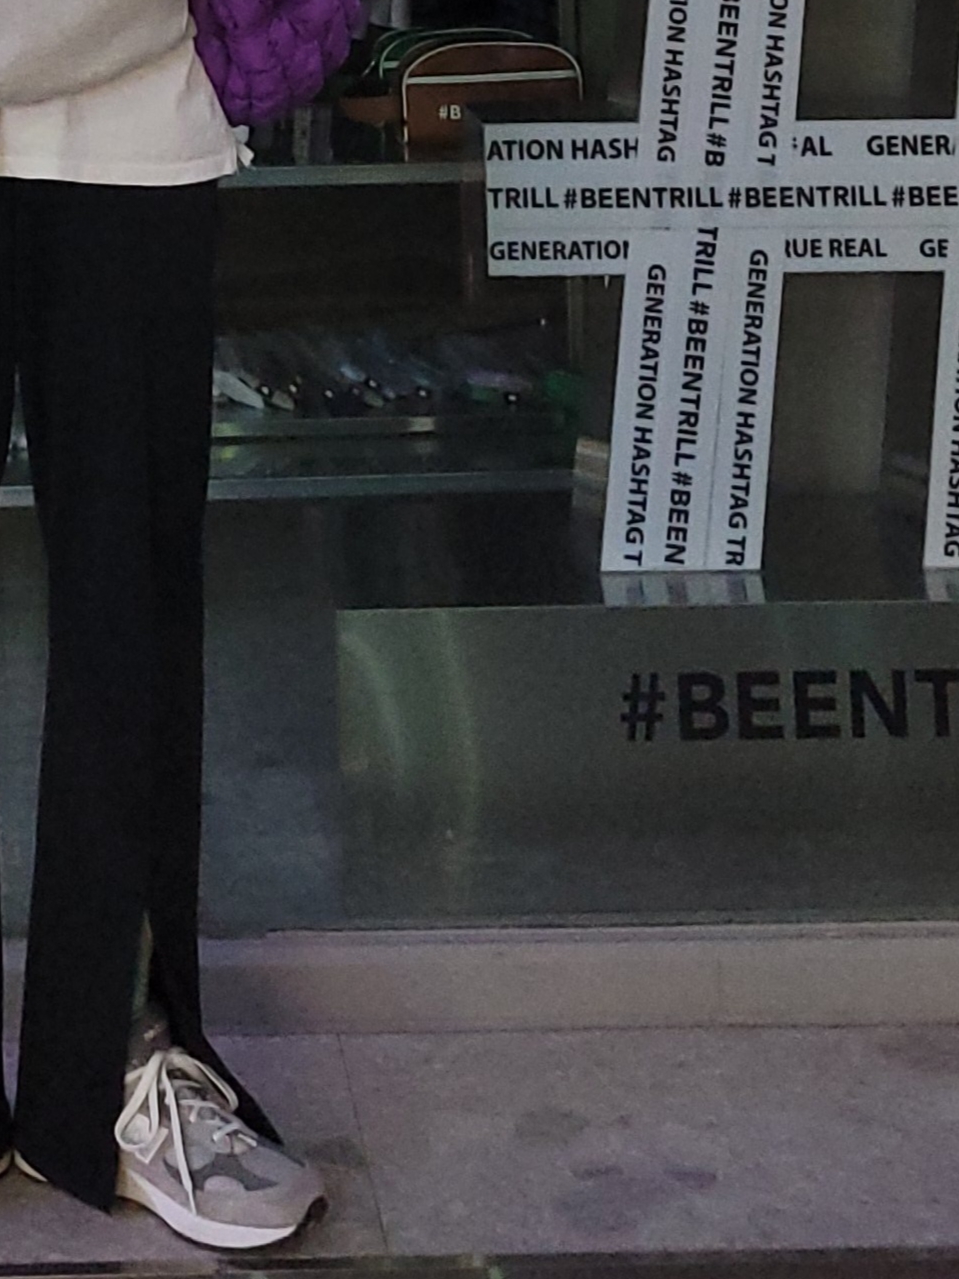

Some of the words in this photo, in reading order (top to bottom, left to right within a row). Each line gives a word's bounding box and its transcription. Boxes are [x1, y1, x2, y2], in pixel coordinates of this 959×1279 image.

[657, 49, 685, 163] HASHTAG
[758, 34, 785, 149] HASHTAG
[866, 135, 956, 156] GENER
[487, 139, 564, 161] ATION
[487, 187, 559, 209] TRILL
[564, 187, 723, 209] #BEENTRILL
[728, 185, 887, 209] #BEENTRILL
[829, 238, 888, 258] REAL
[635, 264, 667, 420] GENERATION
[737, 249, 769, 405] GENERATION
[625, 426, 653, 545] HASHTAG
[728, 411, 756, 529] HASHTAG
